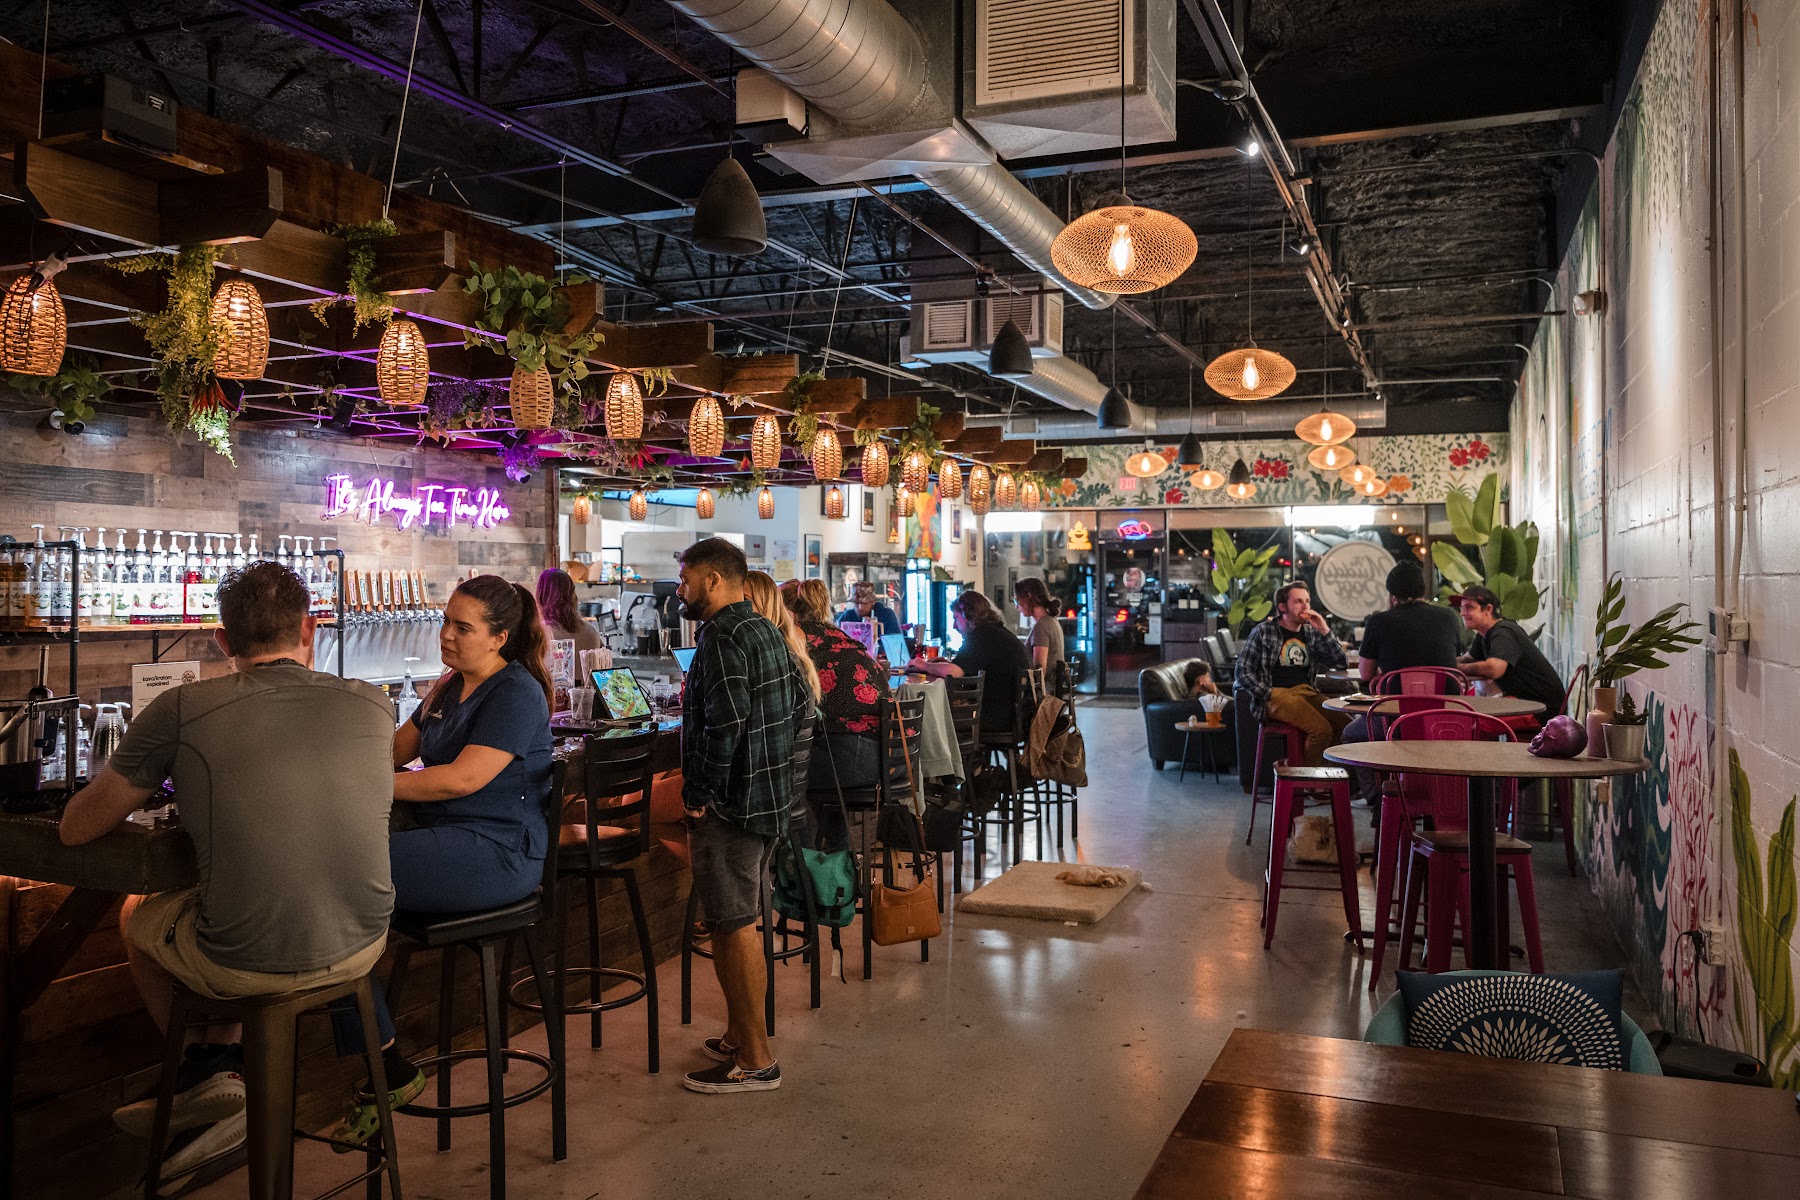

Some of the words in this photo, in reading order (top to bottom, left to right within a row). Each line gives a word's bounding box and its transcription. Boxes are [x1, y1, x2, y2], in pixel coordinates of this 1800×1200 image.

[326, 473, 358, 518] It's
[359, 477, 423, 528] Always
[444, 487, 479, 528] Time
[1119, 477, 1137, 491] EXIT
